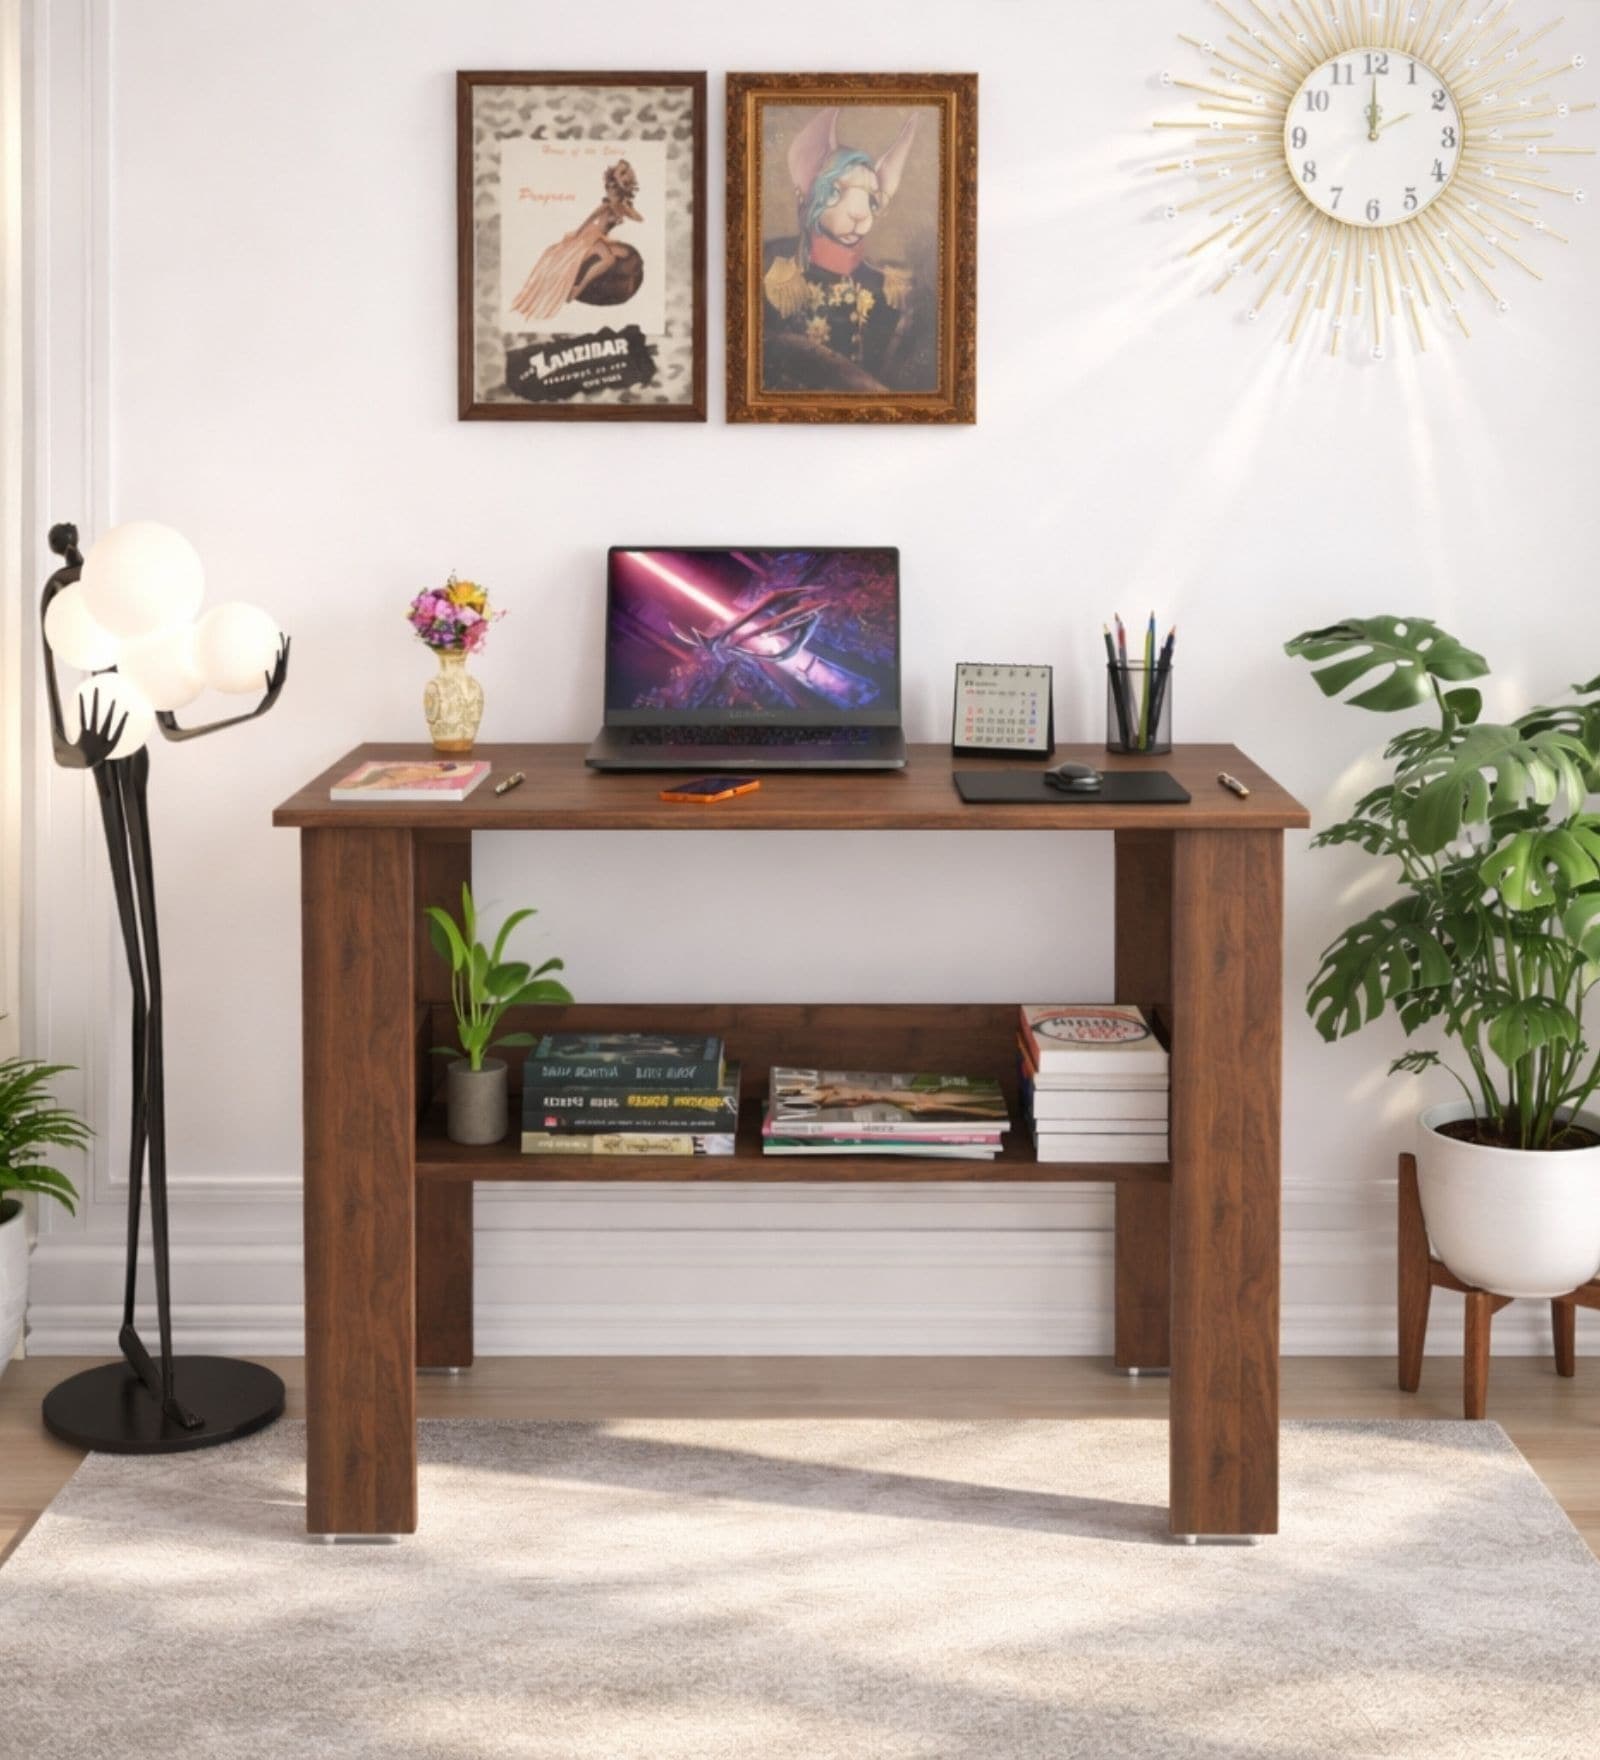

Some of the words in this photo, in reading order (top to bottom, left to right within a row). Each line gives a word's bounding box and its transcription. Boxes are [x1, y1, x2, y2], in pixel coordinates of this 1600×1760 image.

[1331, 63, 1355, 85] 11
[1364, 54, 1389, 75] 12
[1407, 63, 1416, 85] 1
[1304, 90, 1329, 112] 10
[1431, 90, 1446, 111] 2
[1292, 127, 1307, 149] 9
[1441, 127, 1456, 148] 3
[1302, 161, 1316, 183] 8
[1431, 158, 1447, 182] 4
[1330, 187, 1343, 210] 7
[1403, 187, 1418, 210] 5
[1366, 200, 1379, 222] 6
